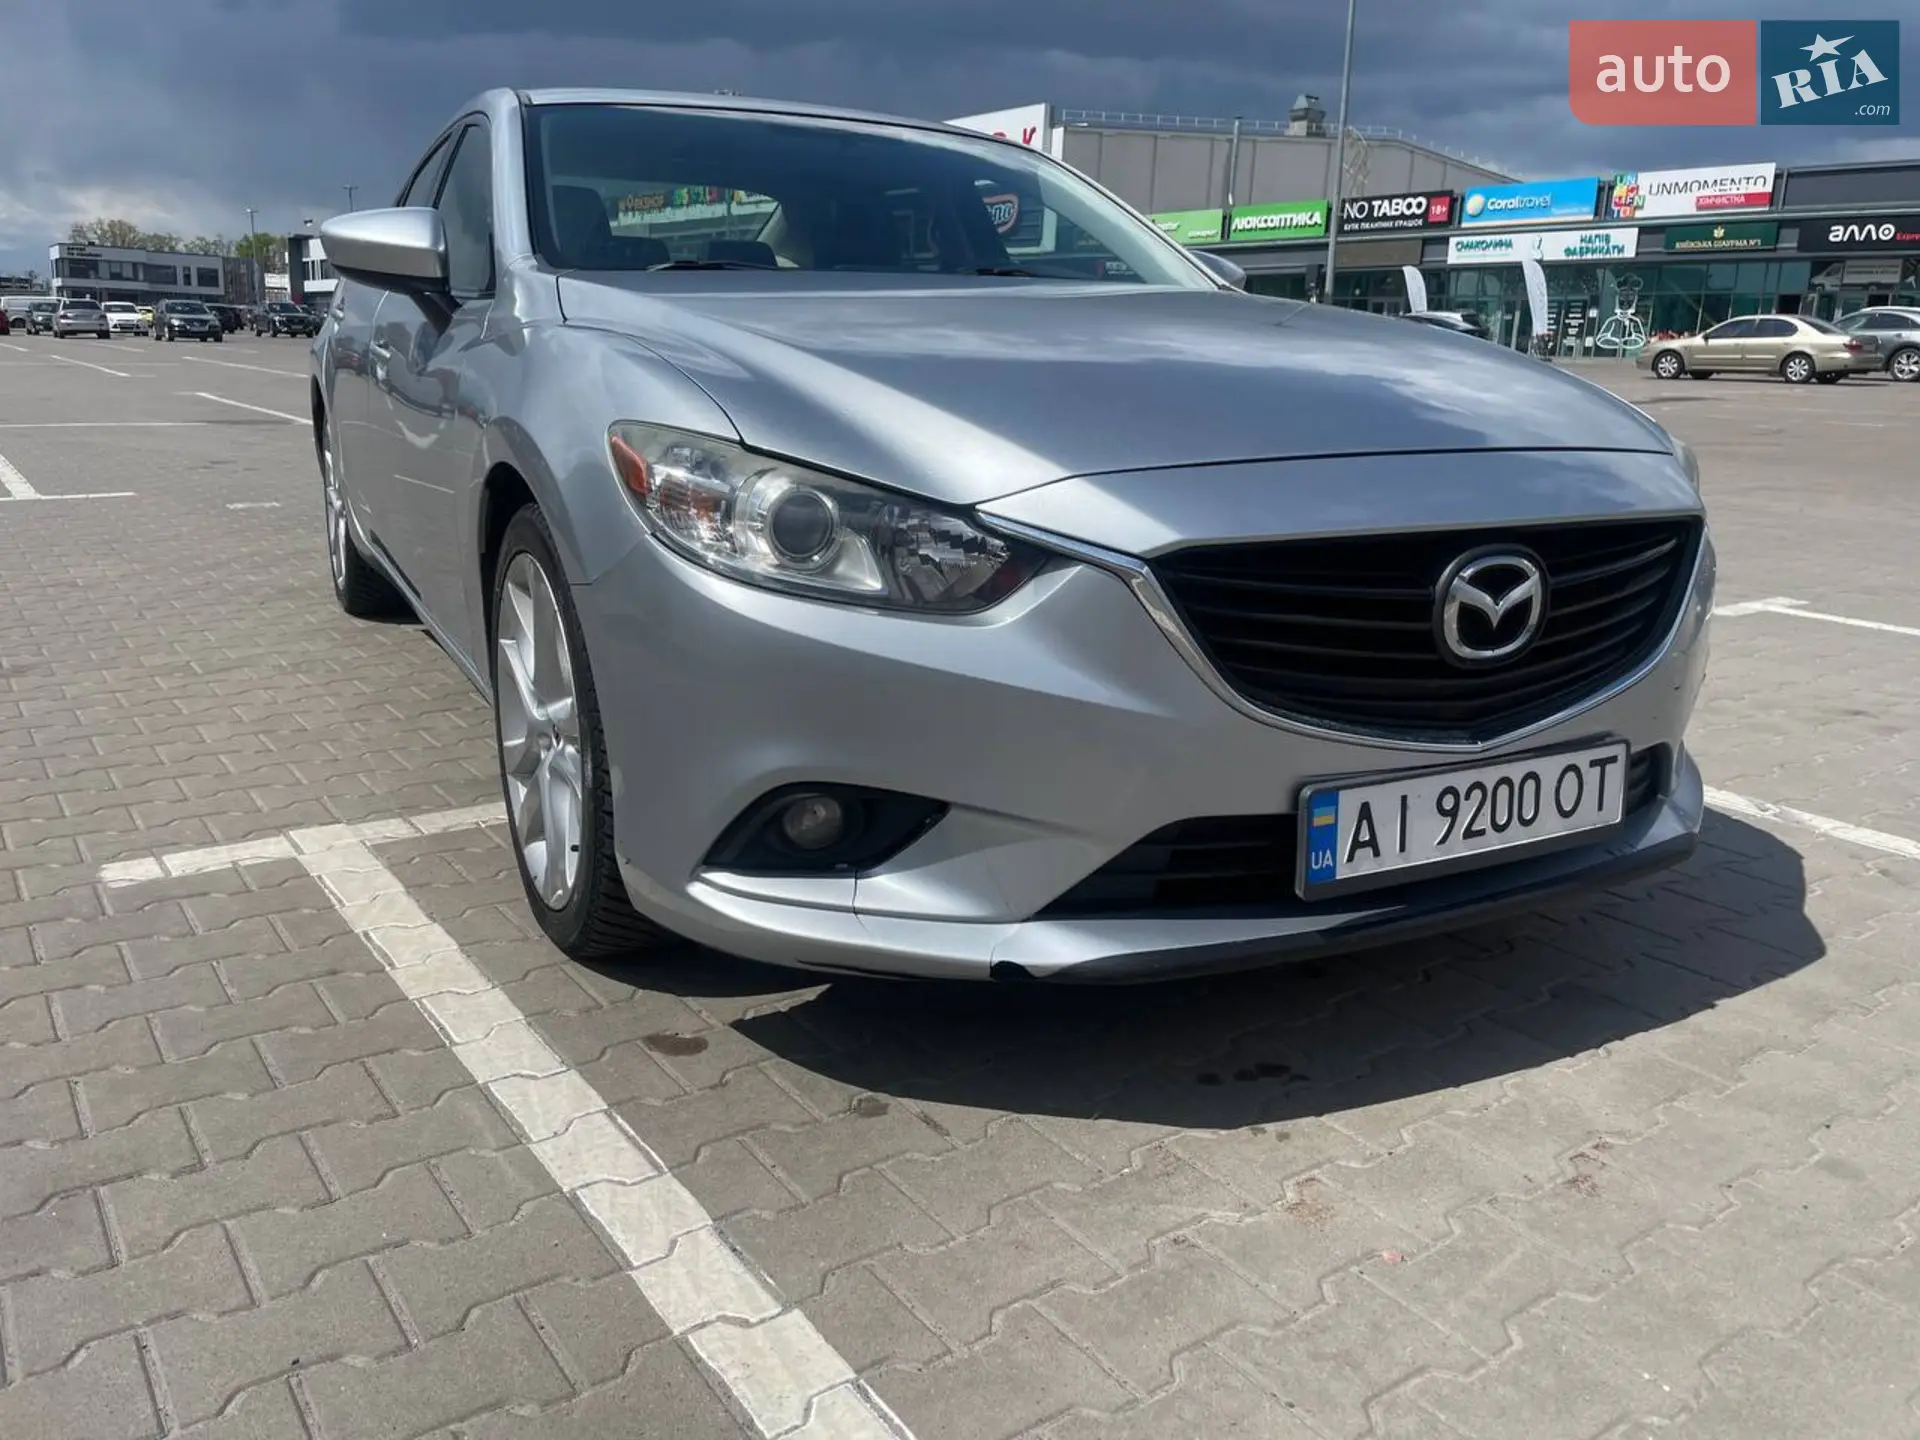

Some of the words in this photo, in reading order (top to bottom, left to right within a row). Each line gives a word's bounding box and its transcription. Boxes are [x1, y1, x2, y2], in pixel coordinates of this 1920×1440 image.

[1649, 174, 1767, 196] UNMOMENTO
[1343, 201, 1369, 219] NO
[1372, 197, 1427, 217] TABOO
[1232, 212, 1321, 230] ЛЮКСОПТИКА
[1343, 795, 1408, 865] AI
[1435, 771, 1542, 847] 9200
[1554, 756, 1619, 819] OT
[1311, 851, 1333, 870] UA
